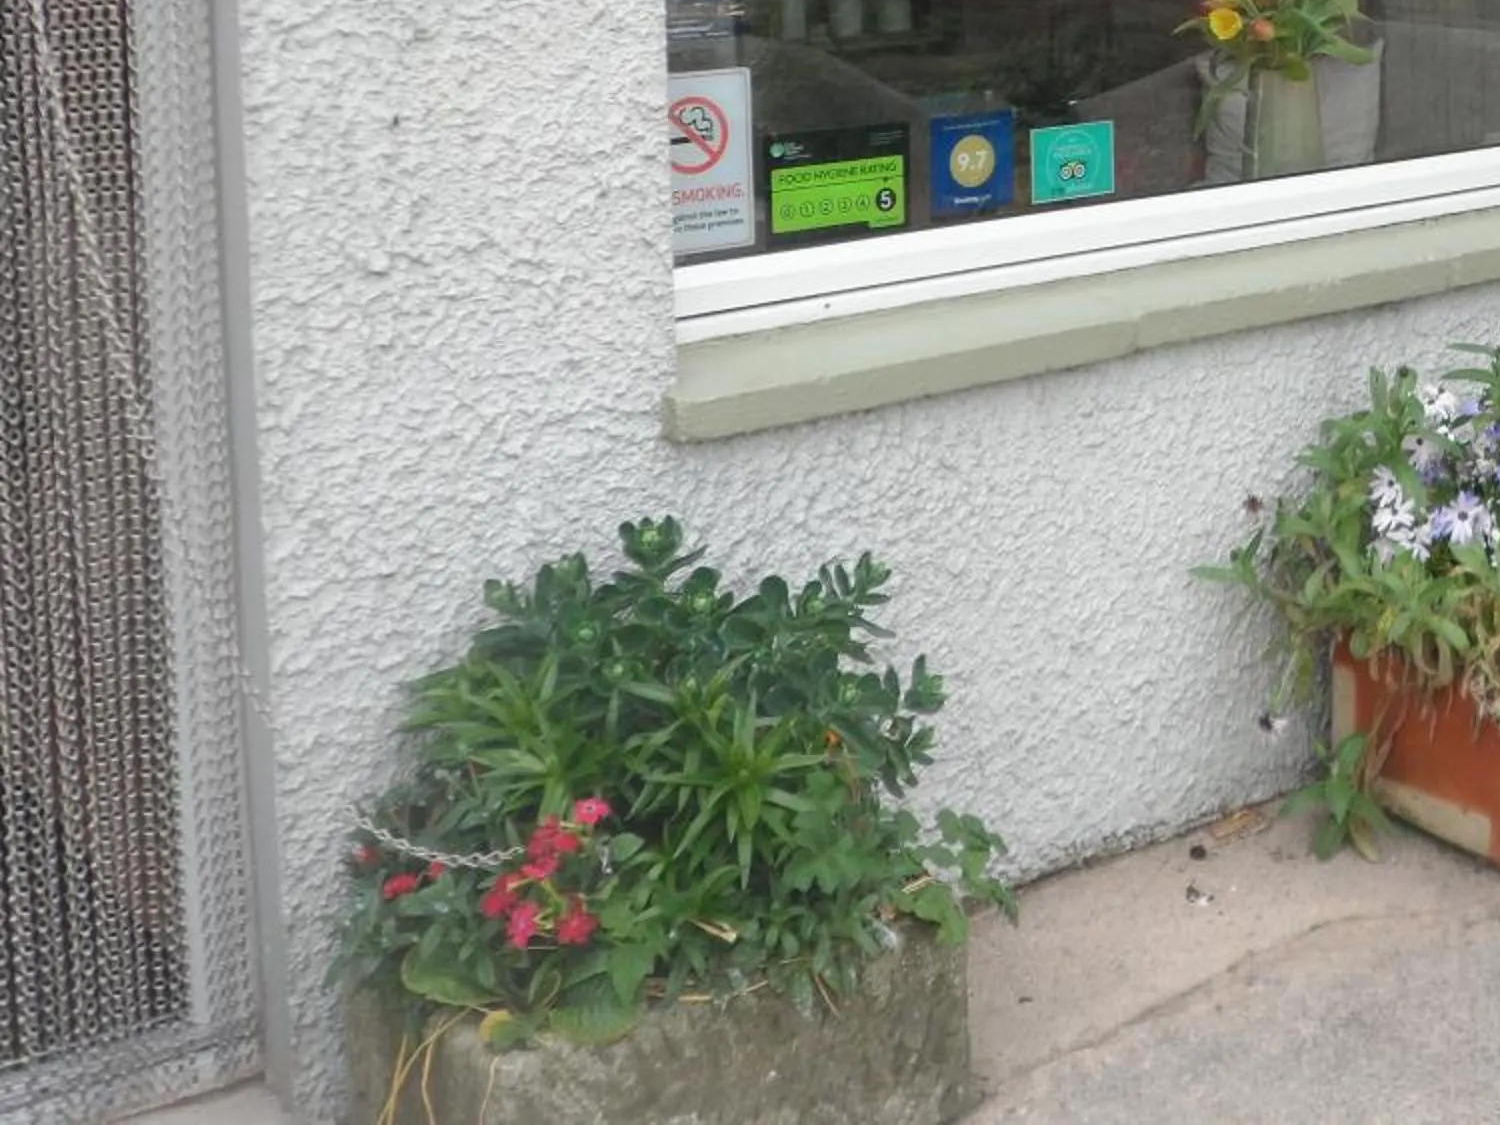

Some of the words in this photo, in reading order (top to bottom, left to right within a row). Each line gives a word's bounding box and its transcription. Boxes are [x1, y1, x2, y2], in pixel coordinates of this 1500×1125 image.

[778, 172, 812, 185] FOOD
[813, 166, 858, 180] HYGIENE
[858, 159, 897, 175] RATING
[957, 150, 992, 172] 9.7
[879, 190, 893, 209] 5
